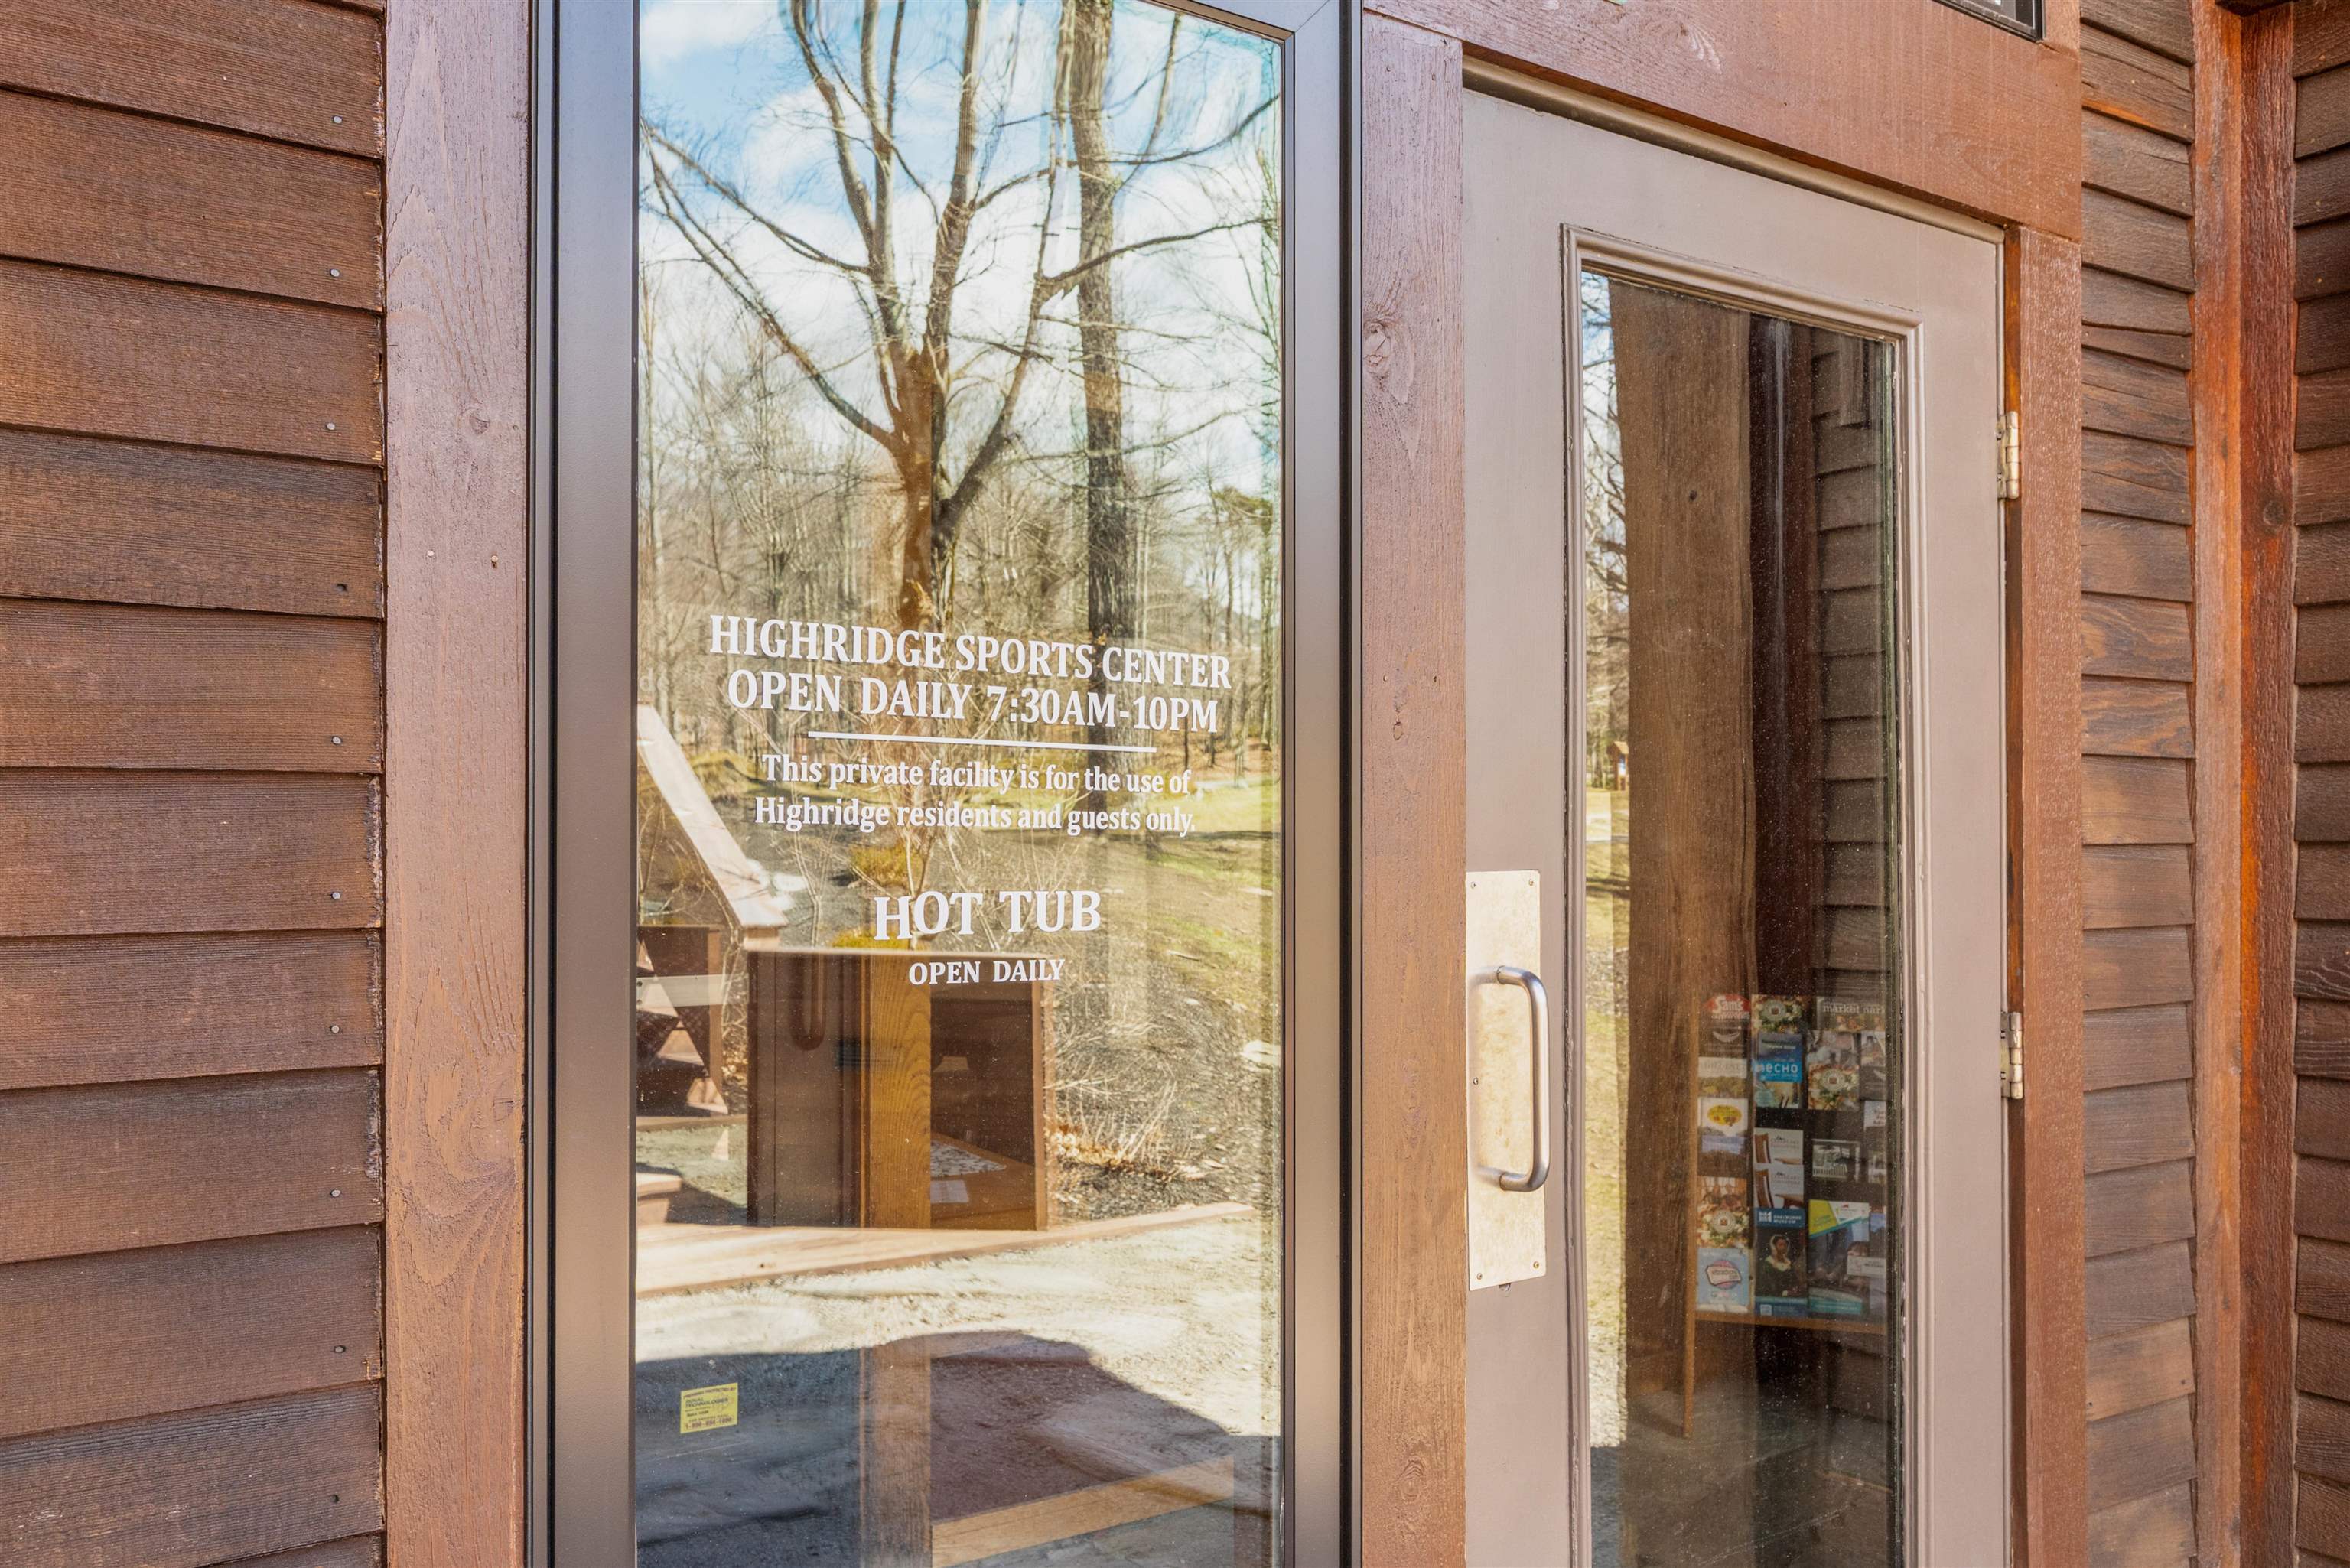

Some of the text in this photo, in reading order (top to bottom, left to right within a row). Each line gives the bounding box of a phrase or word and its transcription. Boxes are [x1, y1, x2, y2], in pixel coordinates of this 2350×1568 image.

[710, 615, 1231, 688] HIGHRIDGE SPORTS CENTER
[727, 669, 1218, 732] OPEN DAILY 7:30AM-10PM
[762, 754, 1193, 794] This private facility is for the use of
[754, 797, 1196, 837] Highridge residents and guests only.
[874, 890, 1102, 940] HOT TUB
[908, 958, 1066, 985] OPEN DAILY
[1712, 996, 1743, 1013] Sam's
